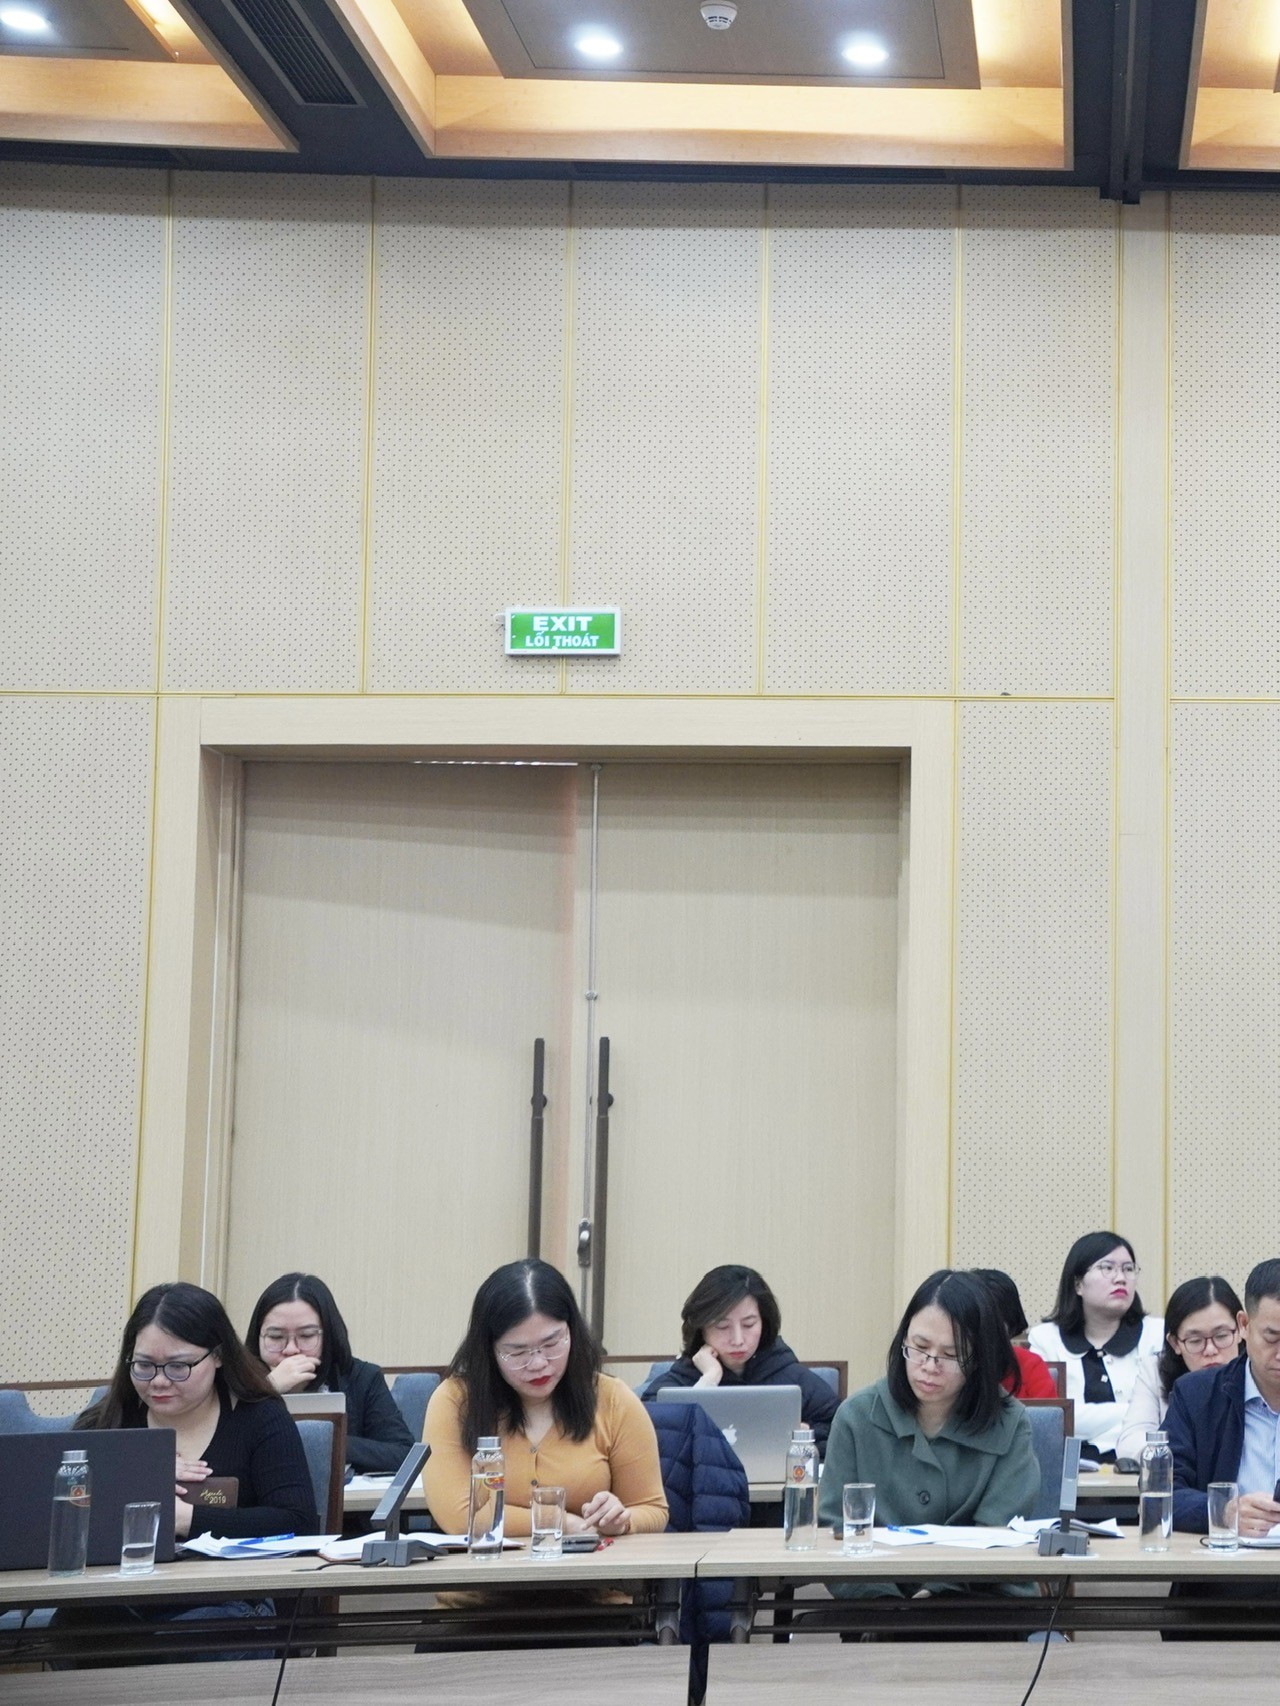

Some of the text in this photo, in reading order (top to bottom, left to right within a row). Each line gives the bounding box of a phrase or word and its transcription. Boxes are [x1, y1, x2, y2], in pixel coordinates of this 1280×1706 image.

[533, 616, 593, 631] EXIT
[553, 633, 599, 647] THOÁT
[209, 1495, 227, 1504] 2019
